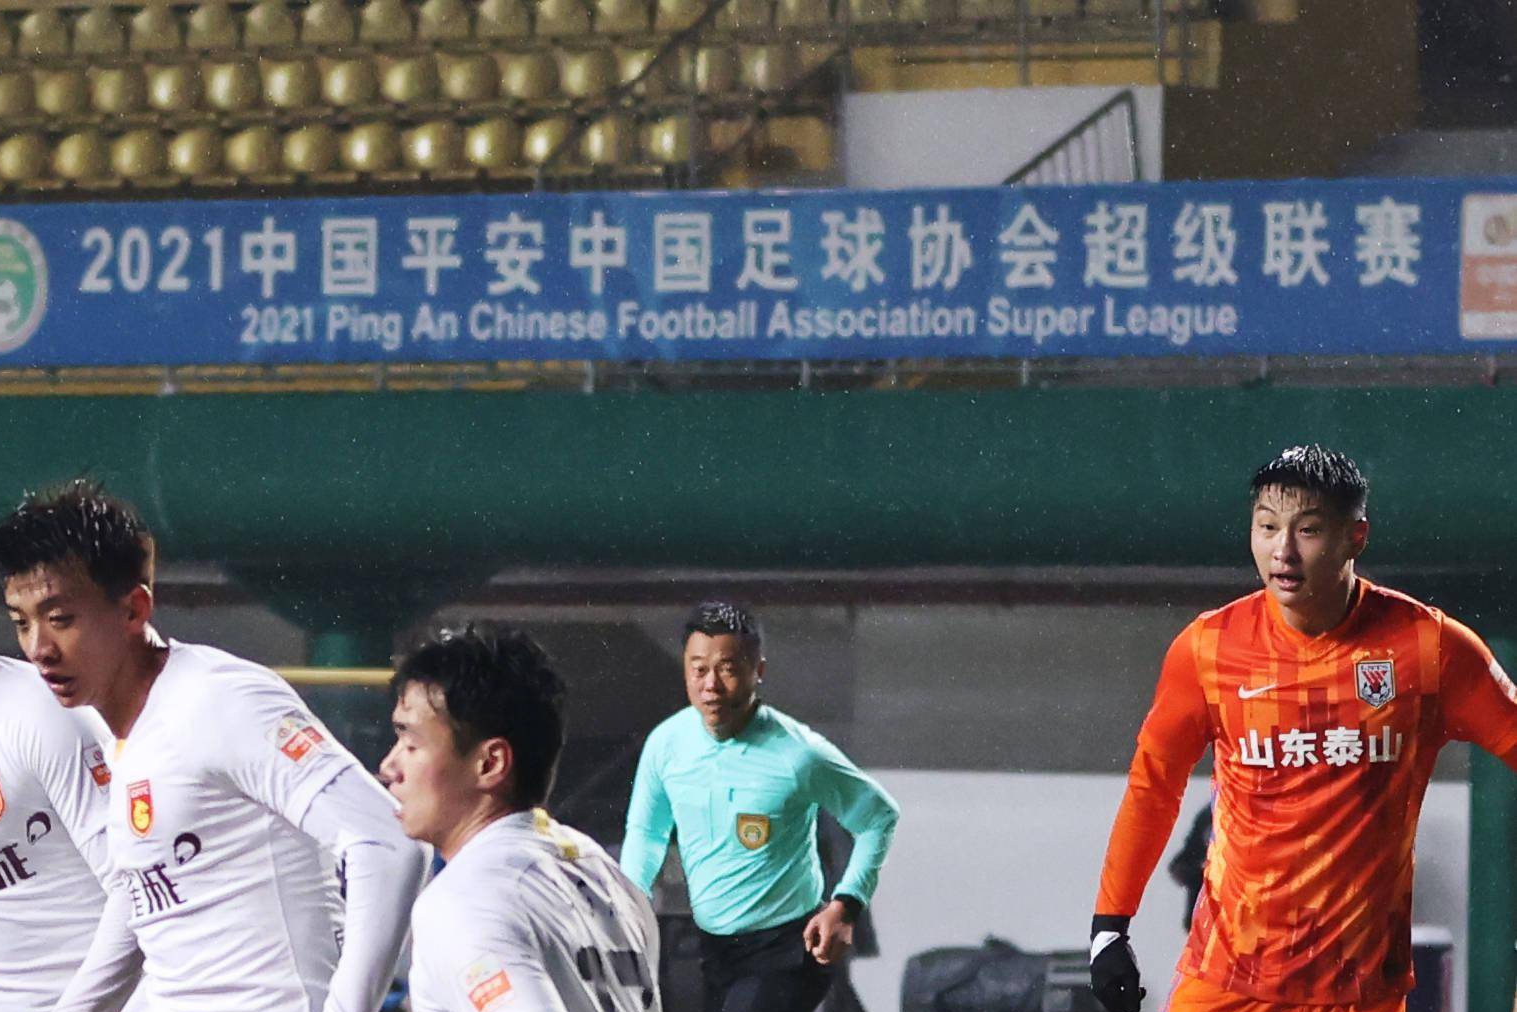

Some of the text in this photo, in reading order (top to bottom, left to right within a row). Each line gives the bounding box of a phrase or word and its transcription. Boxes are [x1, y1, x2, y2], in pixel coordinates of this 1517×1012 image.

[240, 296, 1239, 351] 2021 Ping An Chinese Football Association Super League
[1238, 725, 1403, 769] 山东泰山
